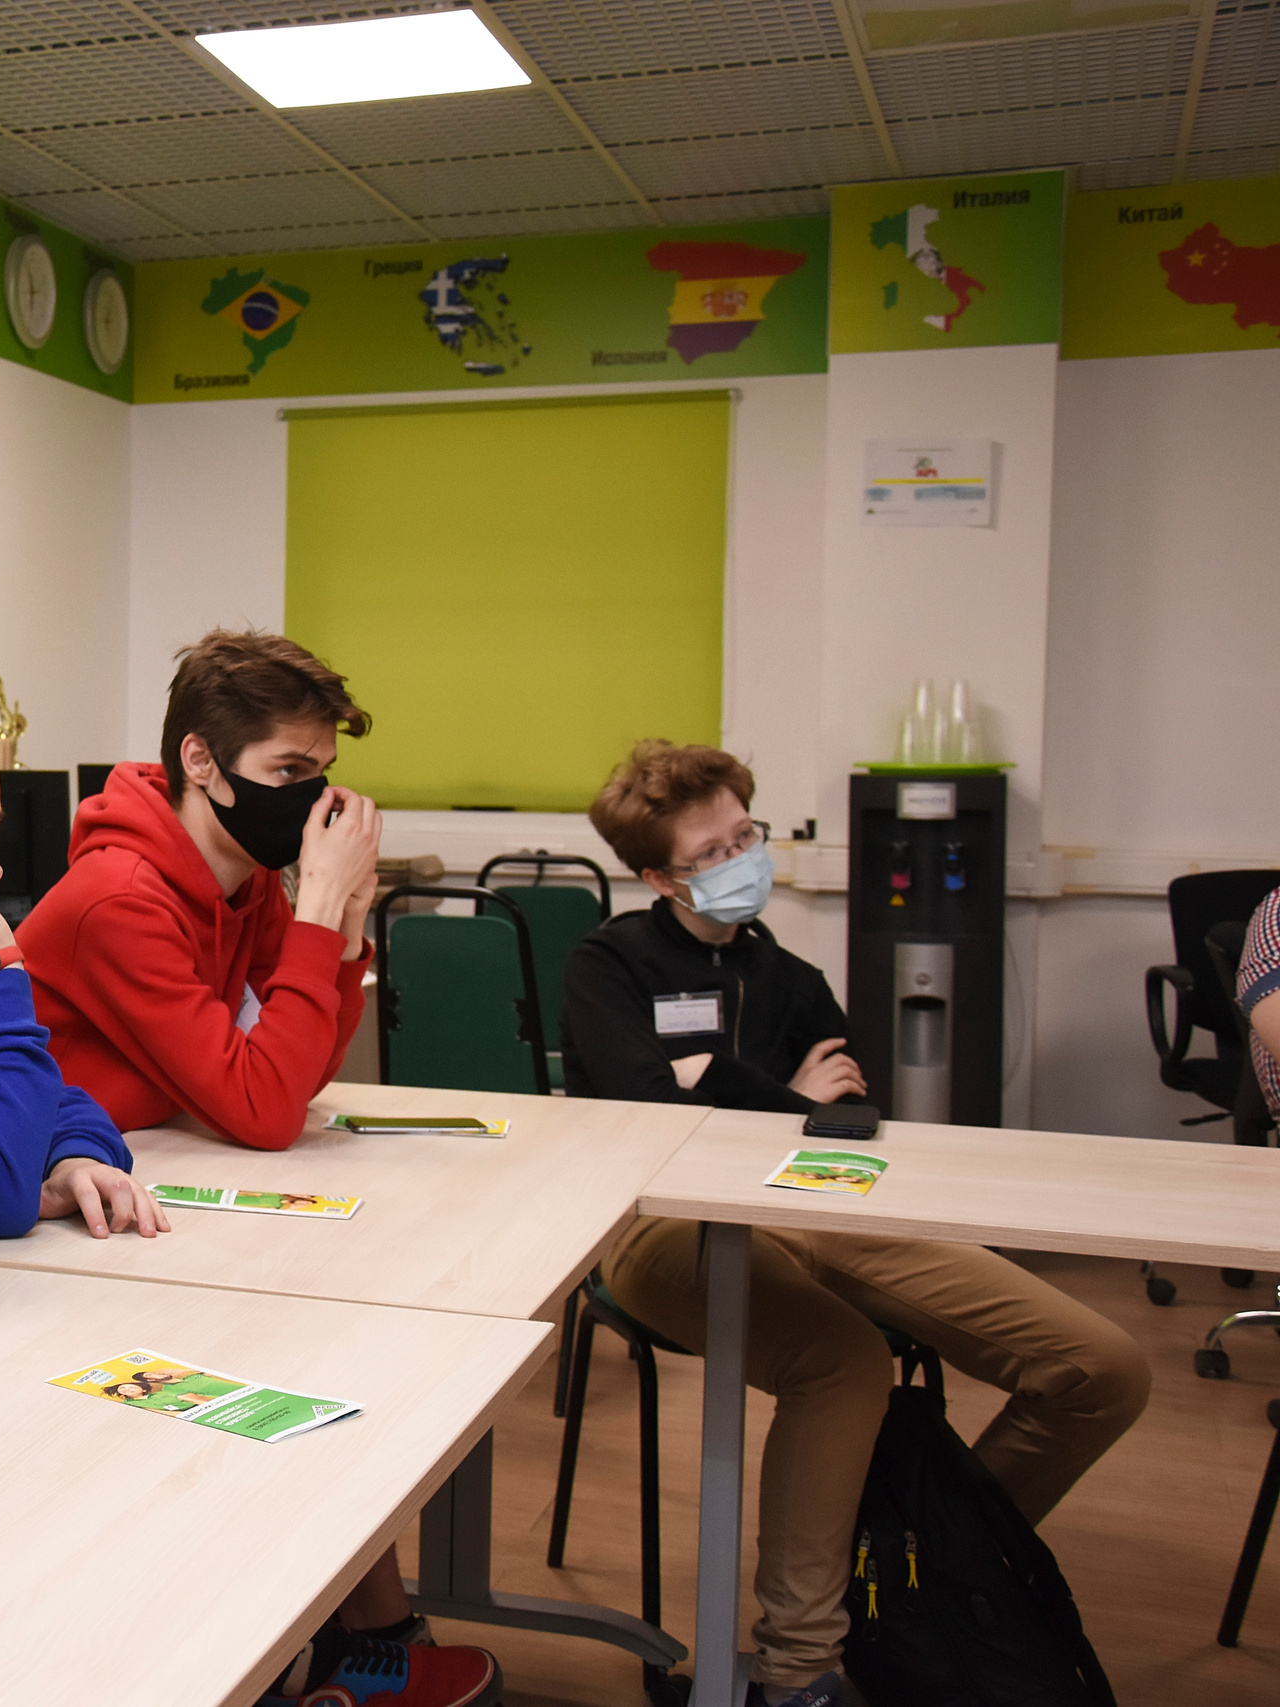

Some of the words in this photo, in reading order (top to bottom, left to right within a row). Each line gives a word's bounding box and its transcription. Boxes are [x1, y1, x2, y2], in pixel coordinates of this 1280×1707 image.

[953, 189, 1031, 209] Италия
[1118, 202, 1184, 225] Китай
[364, 259, 423, 278] Греция
[591, 349, 667, 367] Испания
[174, 374, 250, 391] Бразилия
